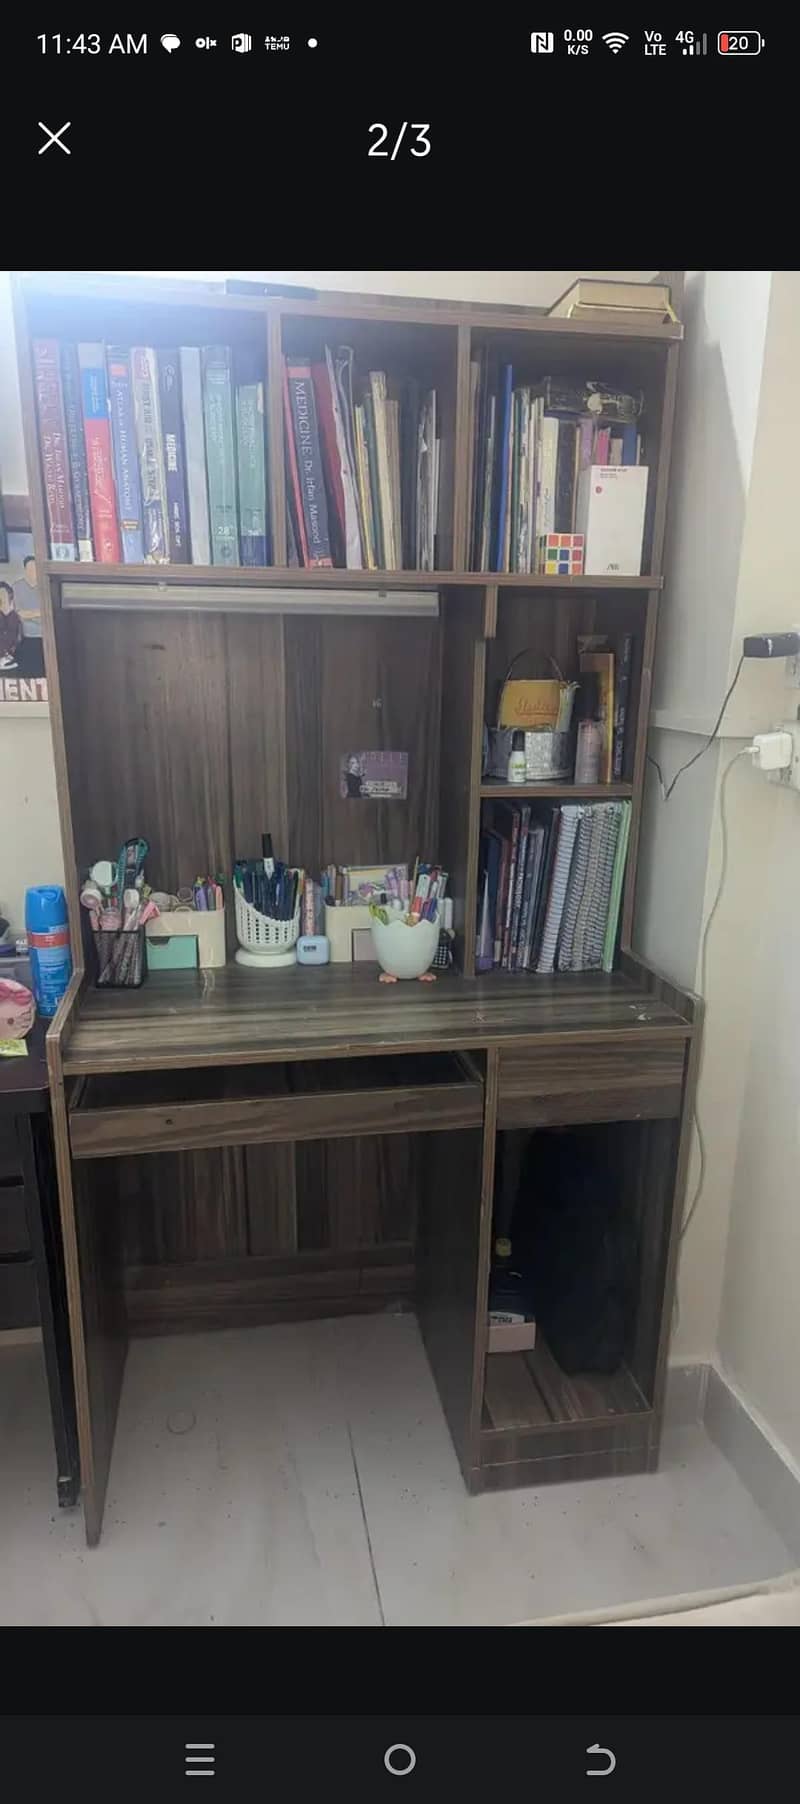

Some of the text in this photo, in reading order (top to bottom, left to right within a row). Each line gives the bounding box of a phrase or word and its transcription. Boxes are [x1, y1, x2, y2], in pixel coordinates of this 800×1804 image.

[295, 381, 313, 456] MEDICINE
[165, 432, 178, 473] MEDICINE
[303, 460, 313, 474] Dr.
[309, 504, 321, 544] Masood
[0, 678, 48, 701] ENT
